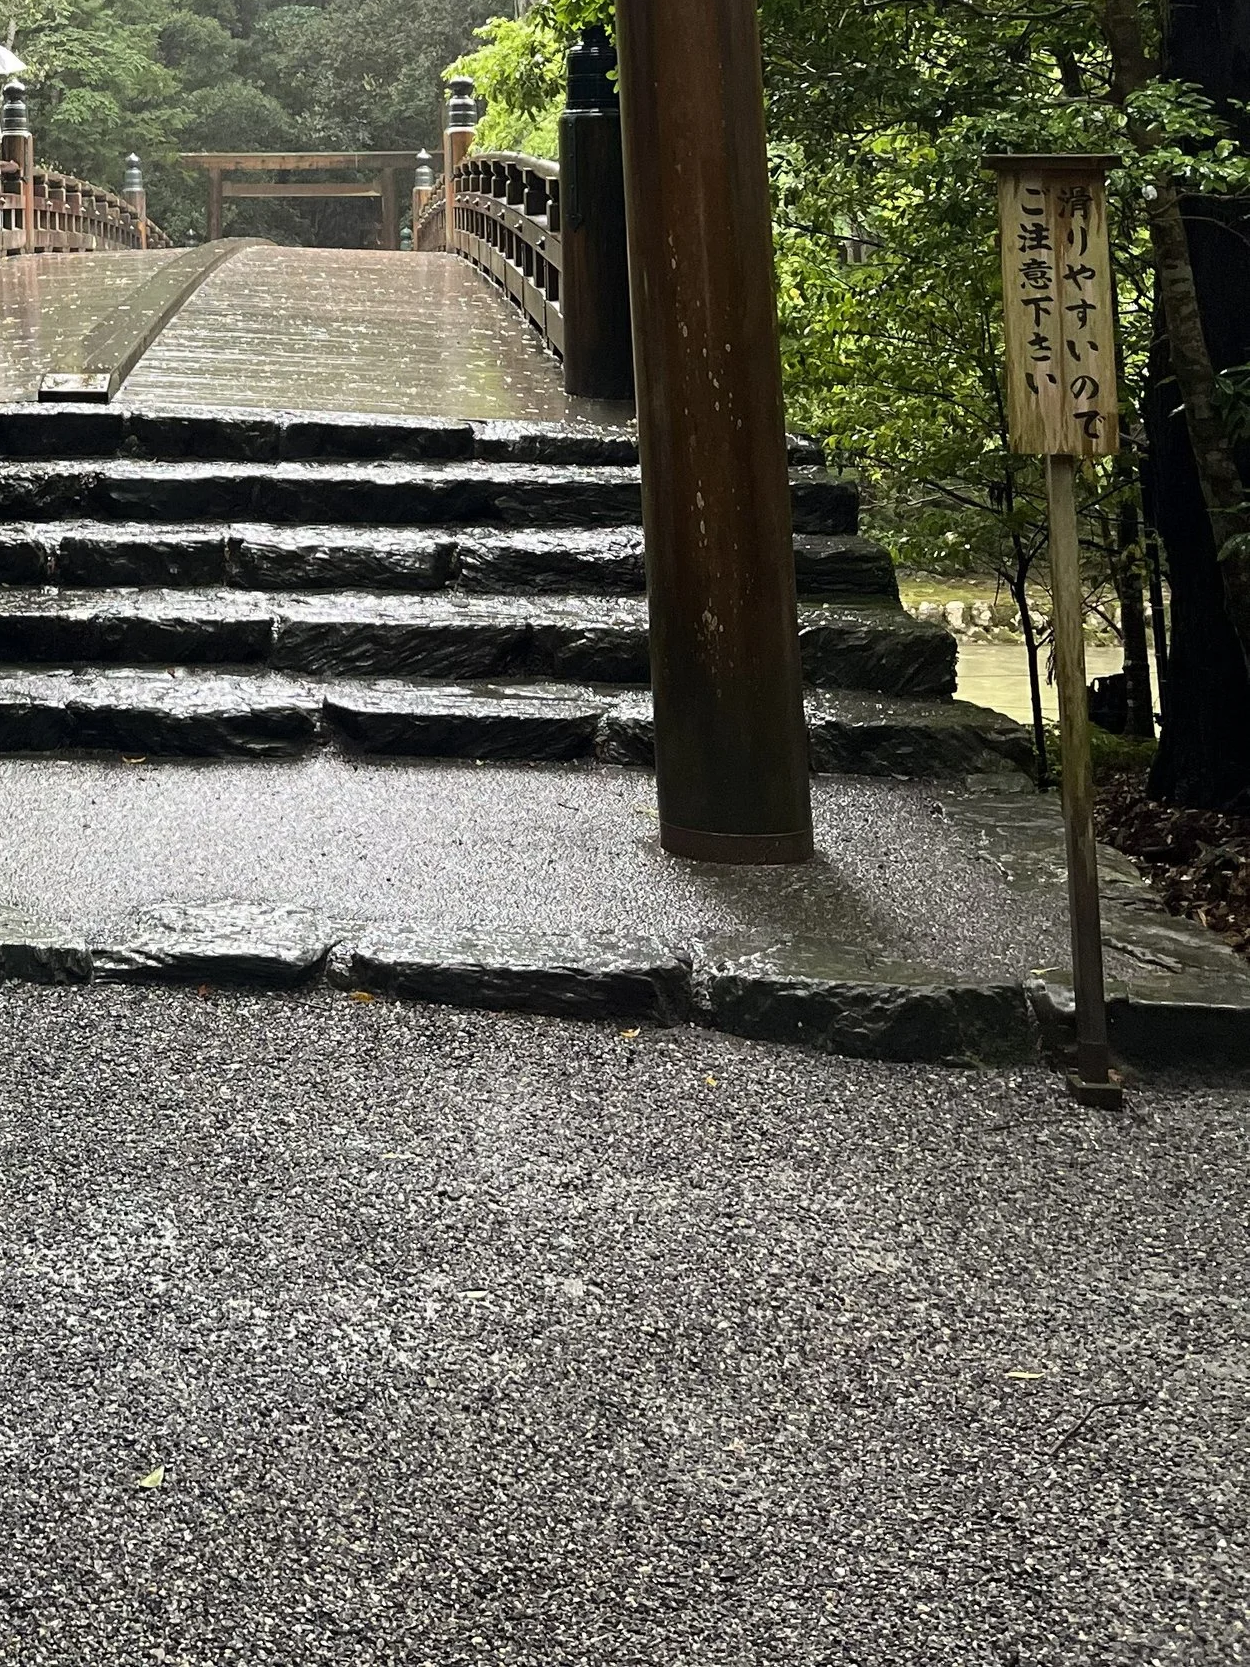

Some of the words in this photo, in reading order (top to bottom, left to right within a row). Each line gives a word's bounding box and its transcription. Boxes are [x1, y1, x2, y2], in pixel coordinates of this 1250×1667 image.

[1016, 187, 1057, 395] ご注意下さい
[1057, 187, 1106, 439] 滑りやすいので
